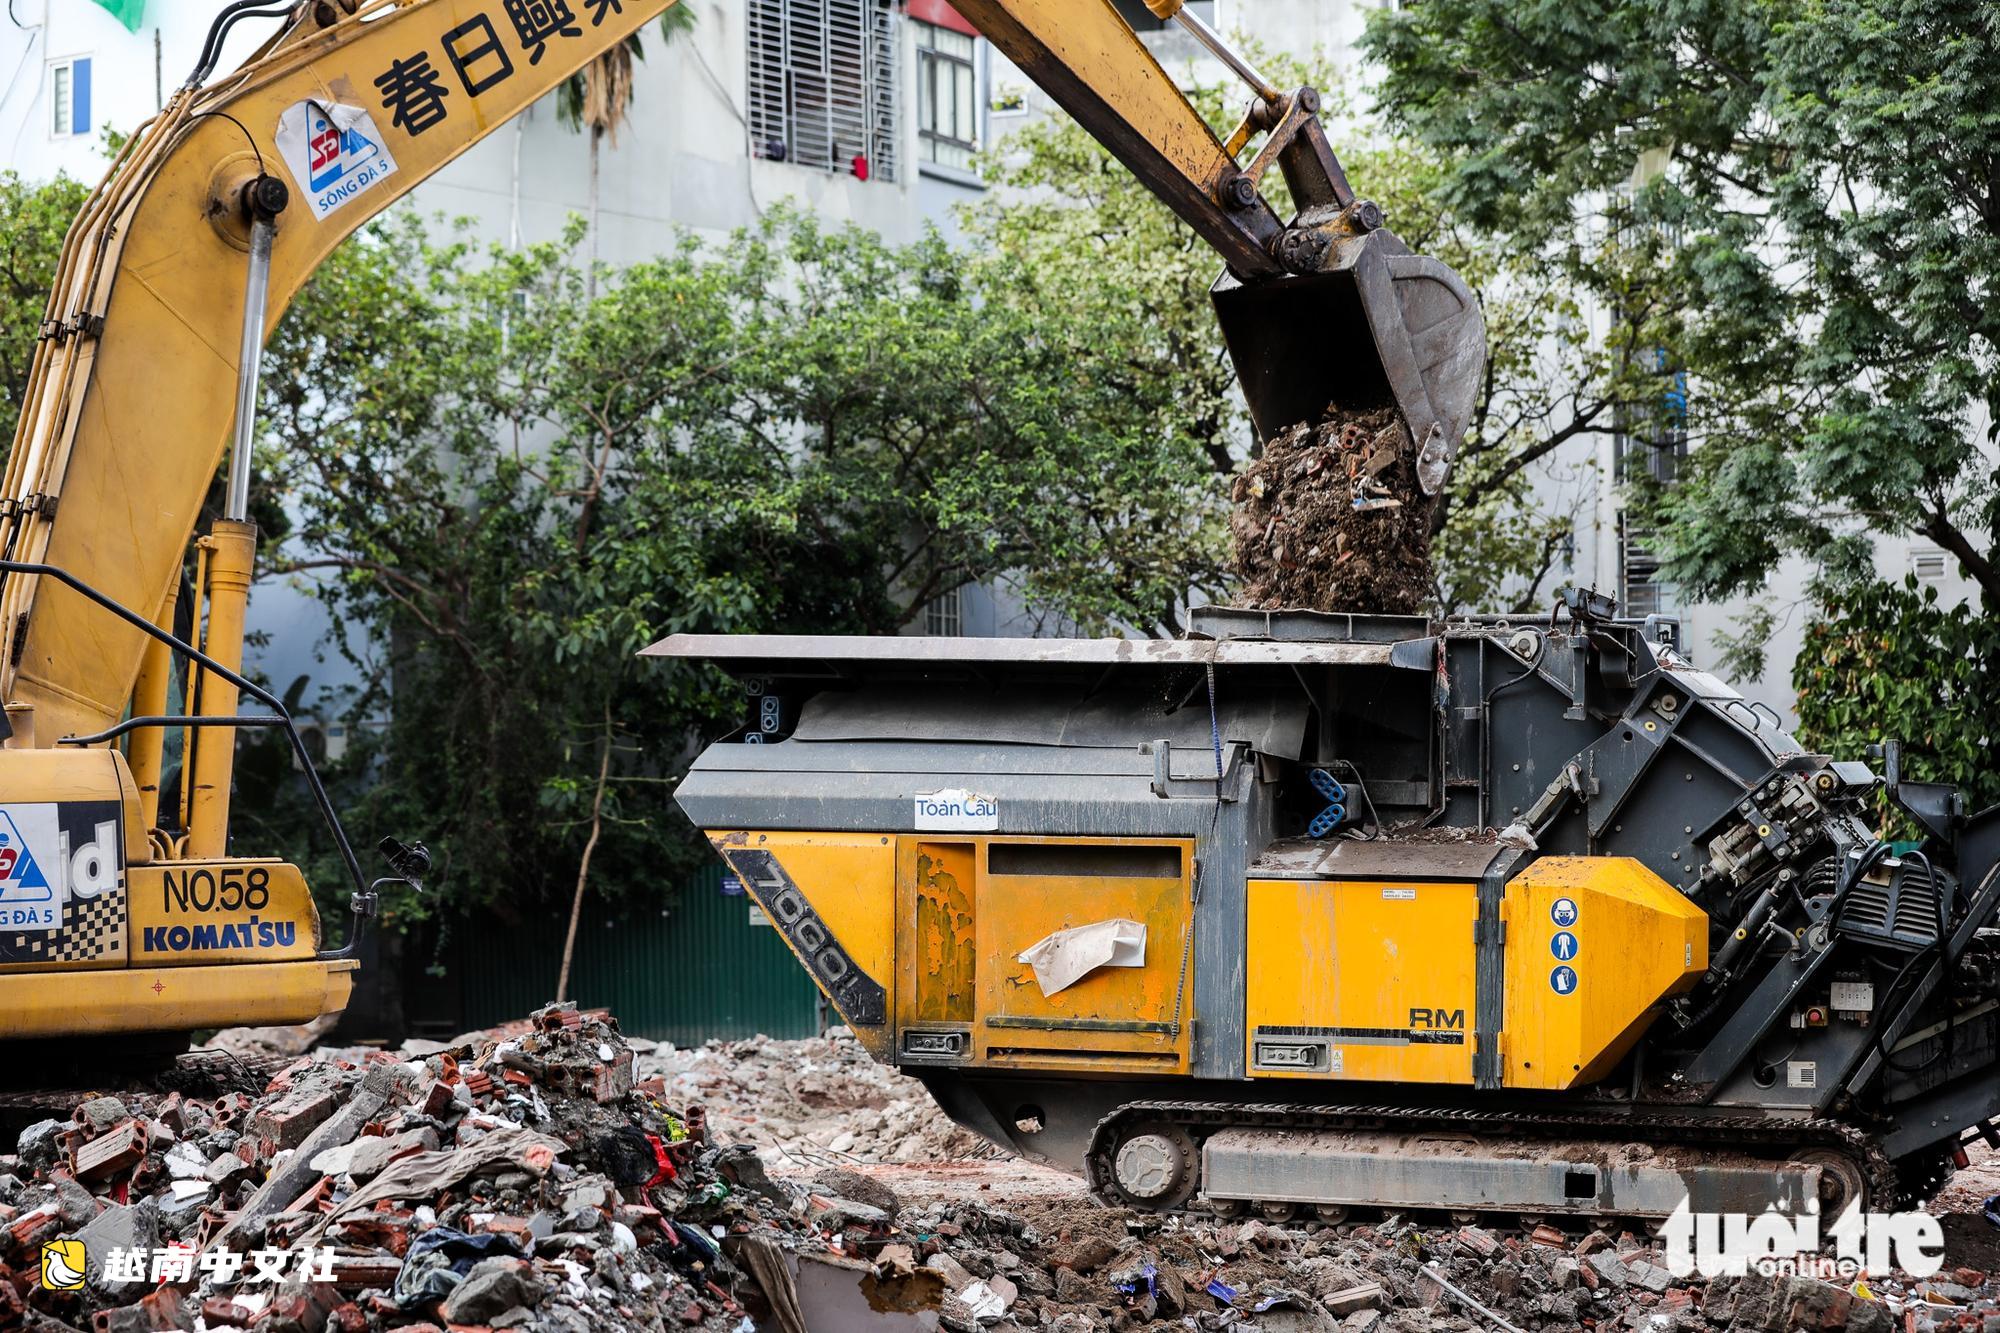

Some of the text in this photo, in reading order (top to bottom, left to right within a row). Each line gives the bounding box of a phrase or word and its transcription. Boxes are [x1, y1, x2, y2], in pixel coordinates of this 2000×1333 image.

[318, 159, 388, 212] SÔNG ĐÀ 5
[916, 800, 960, 816] Toàn
[163, 868, 270, 913] NO.58
[13, 906, 38, 925] ĐÀ
[44, 909, 53, 923] 5
[144, 915, 295, 952] KOMATSU
[1409, 1008, 1465, 1029] RM
